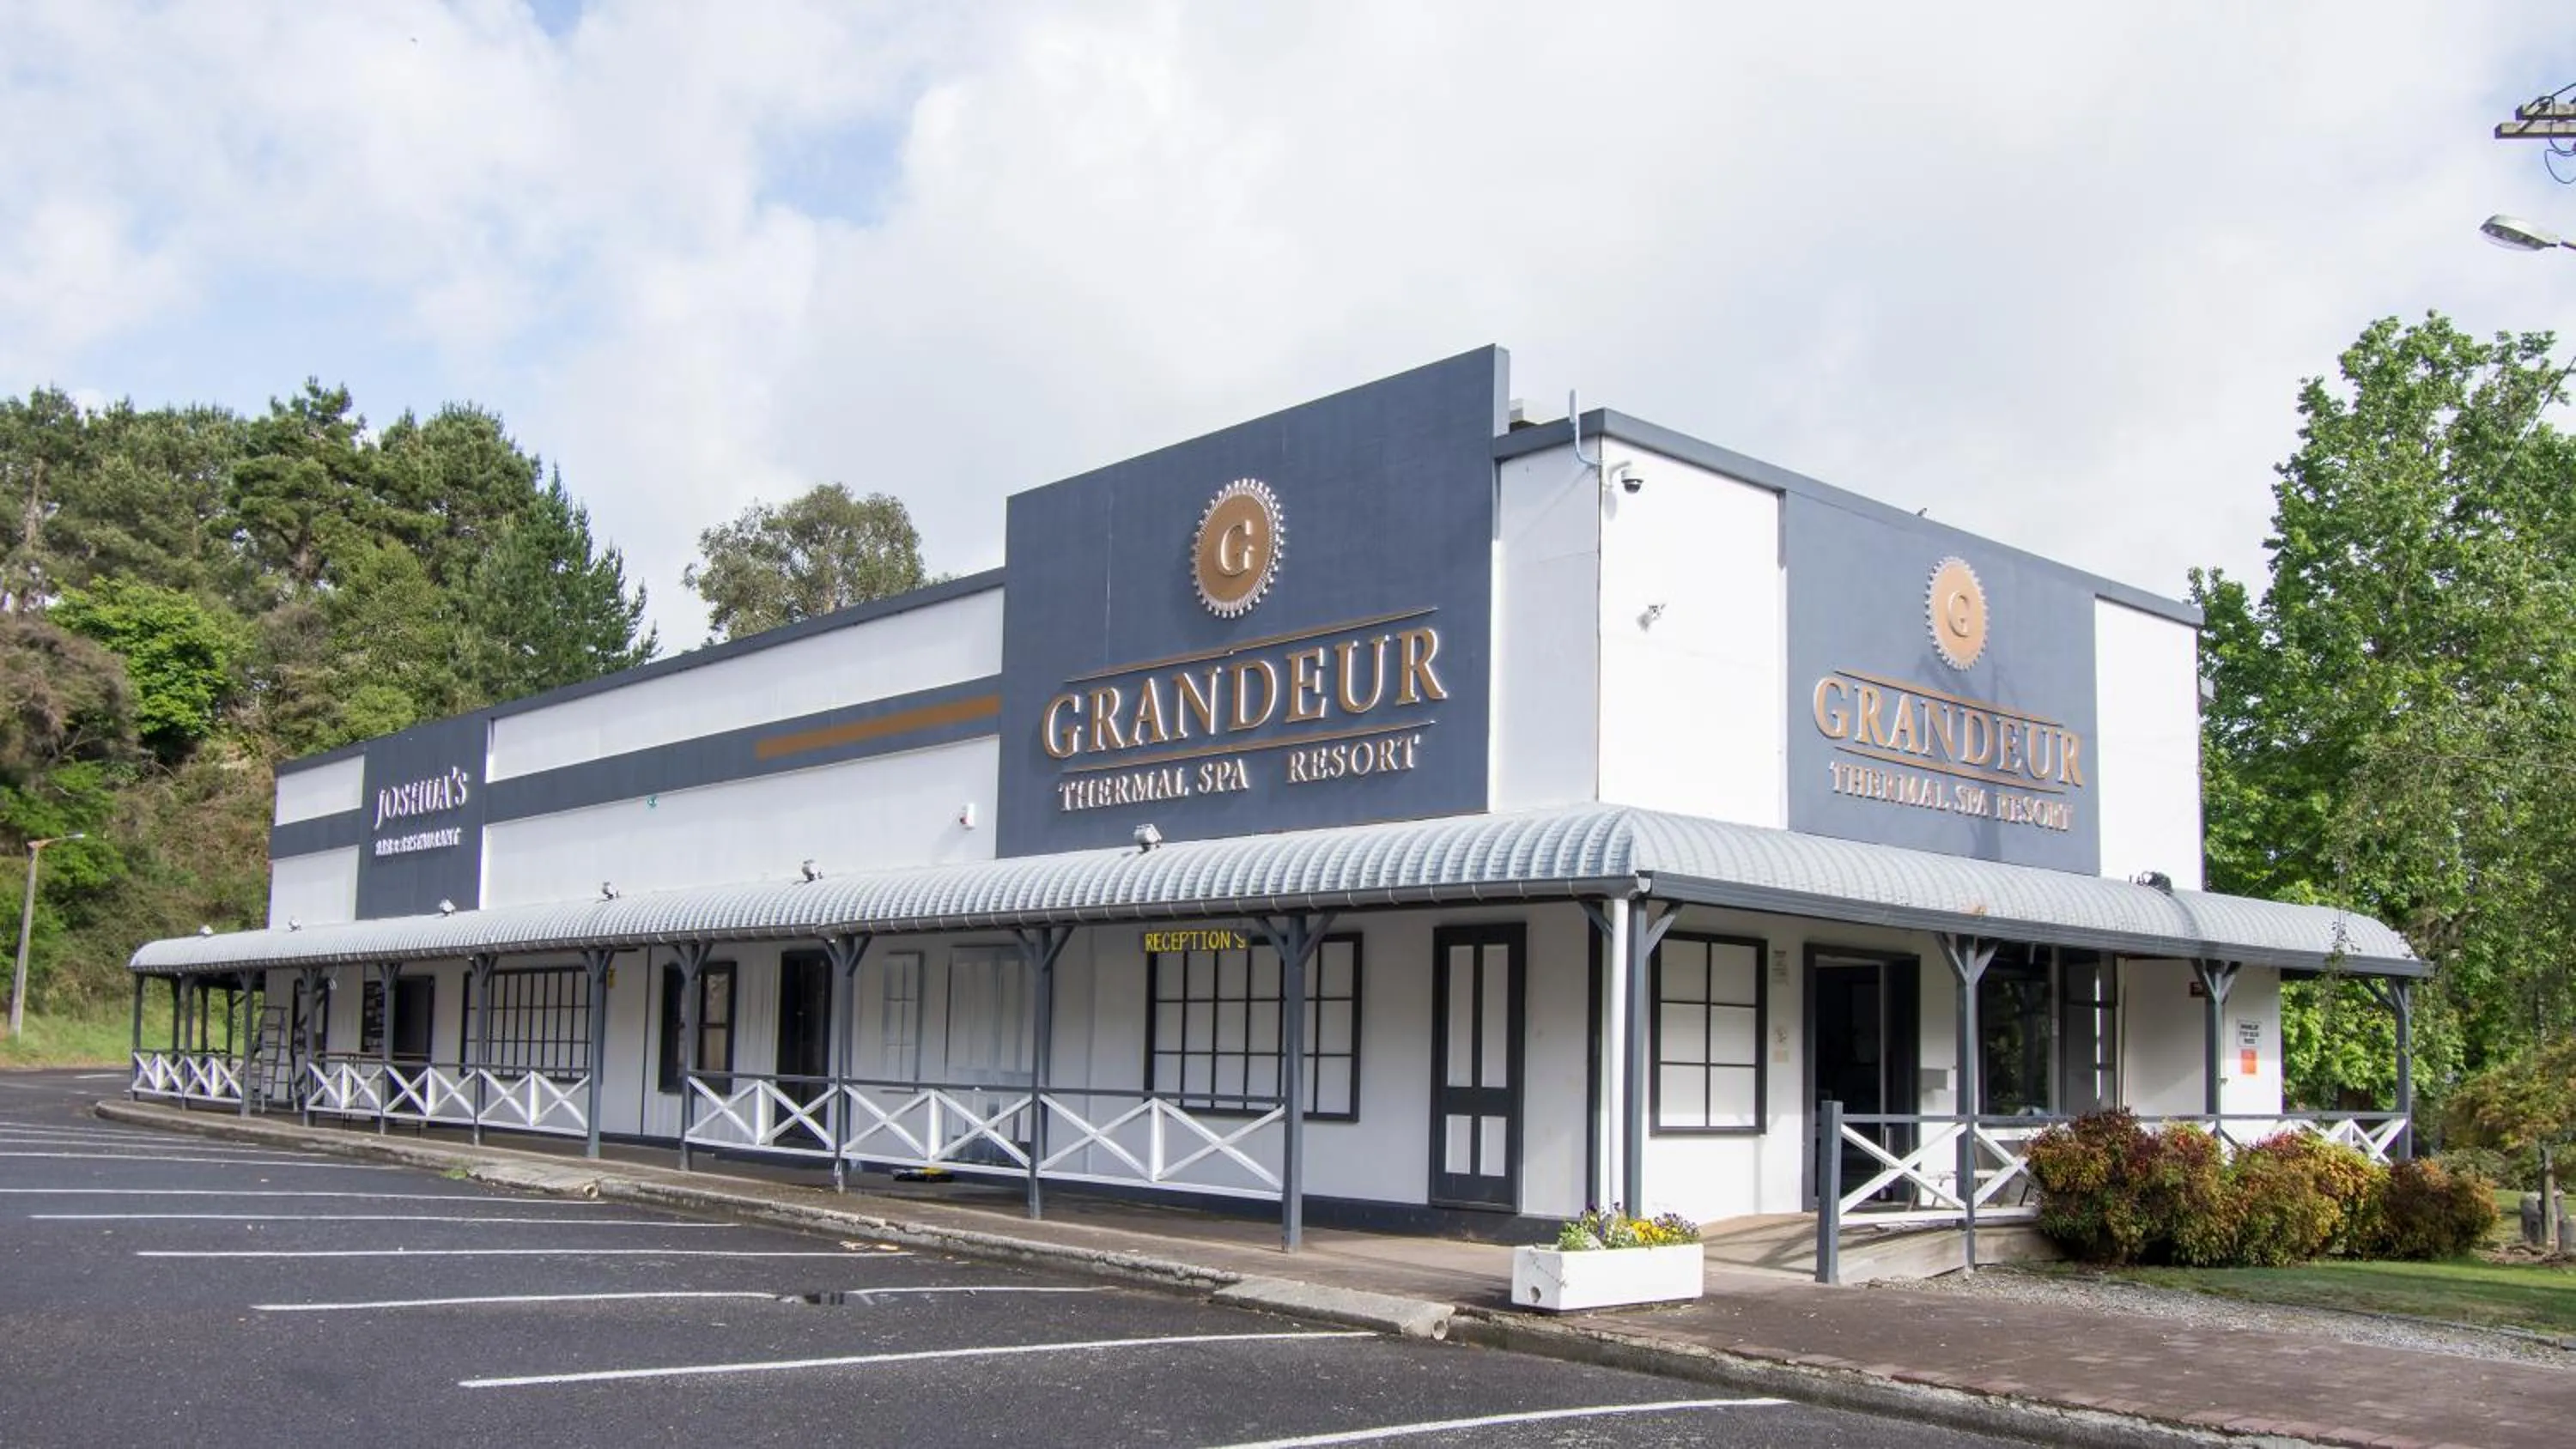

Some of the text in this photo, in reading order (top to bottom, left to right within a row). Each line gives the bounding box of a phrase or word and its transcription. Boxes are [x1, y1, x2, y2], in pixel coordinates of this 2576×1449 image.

[1215, 518, 1253, 577] G
[1947, 590, 1971, 639] G
[1042, 627, 1448, 759] GRANDEUR
[1813, 676, 2082, 787] GRANDEUR
[374, 765, 469, 832] JOSHUA'S
[1057, 734, 1421, 812] THERMAL SPA RESORT
[1829, 761, 2074, 832] THERMAL SPA RESORT
[1145, 931, 1230, 951] RECEPTION
